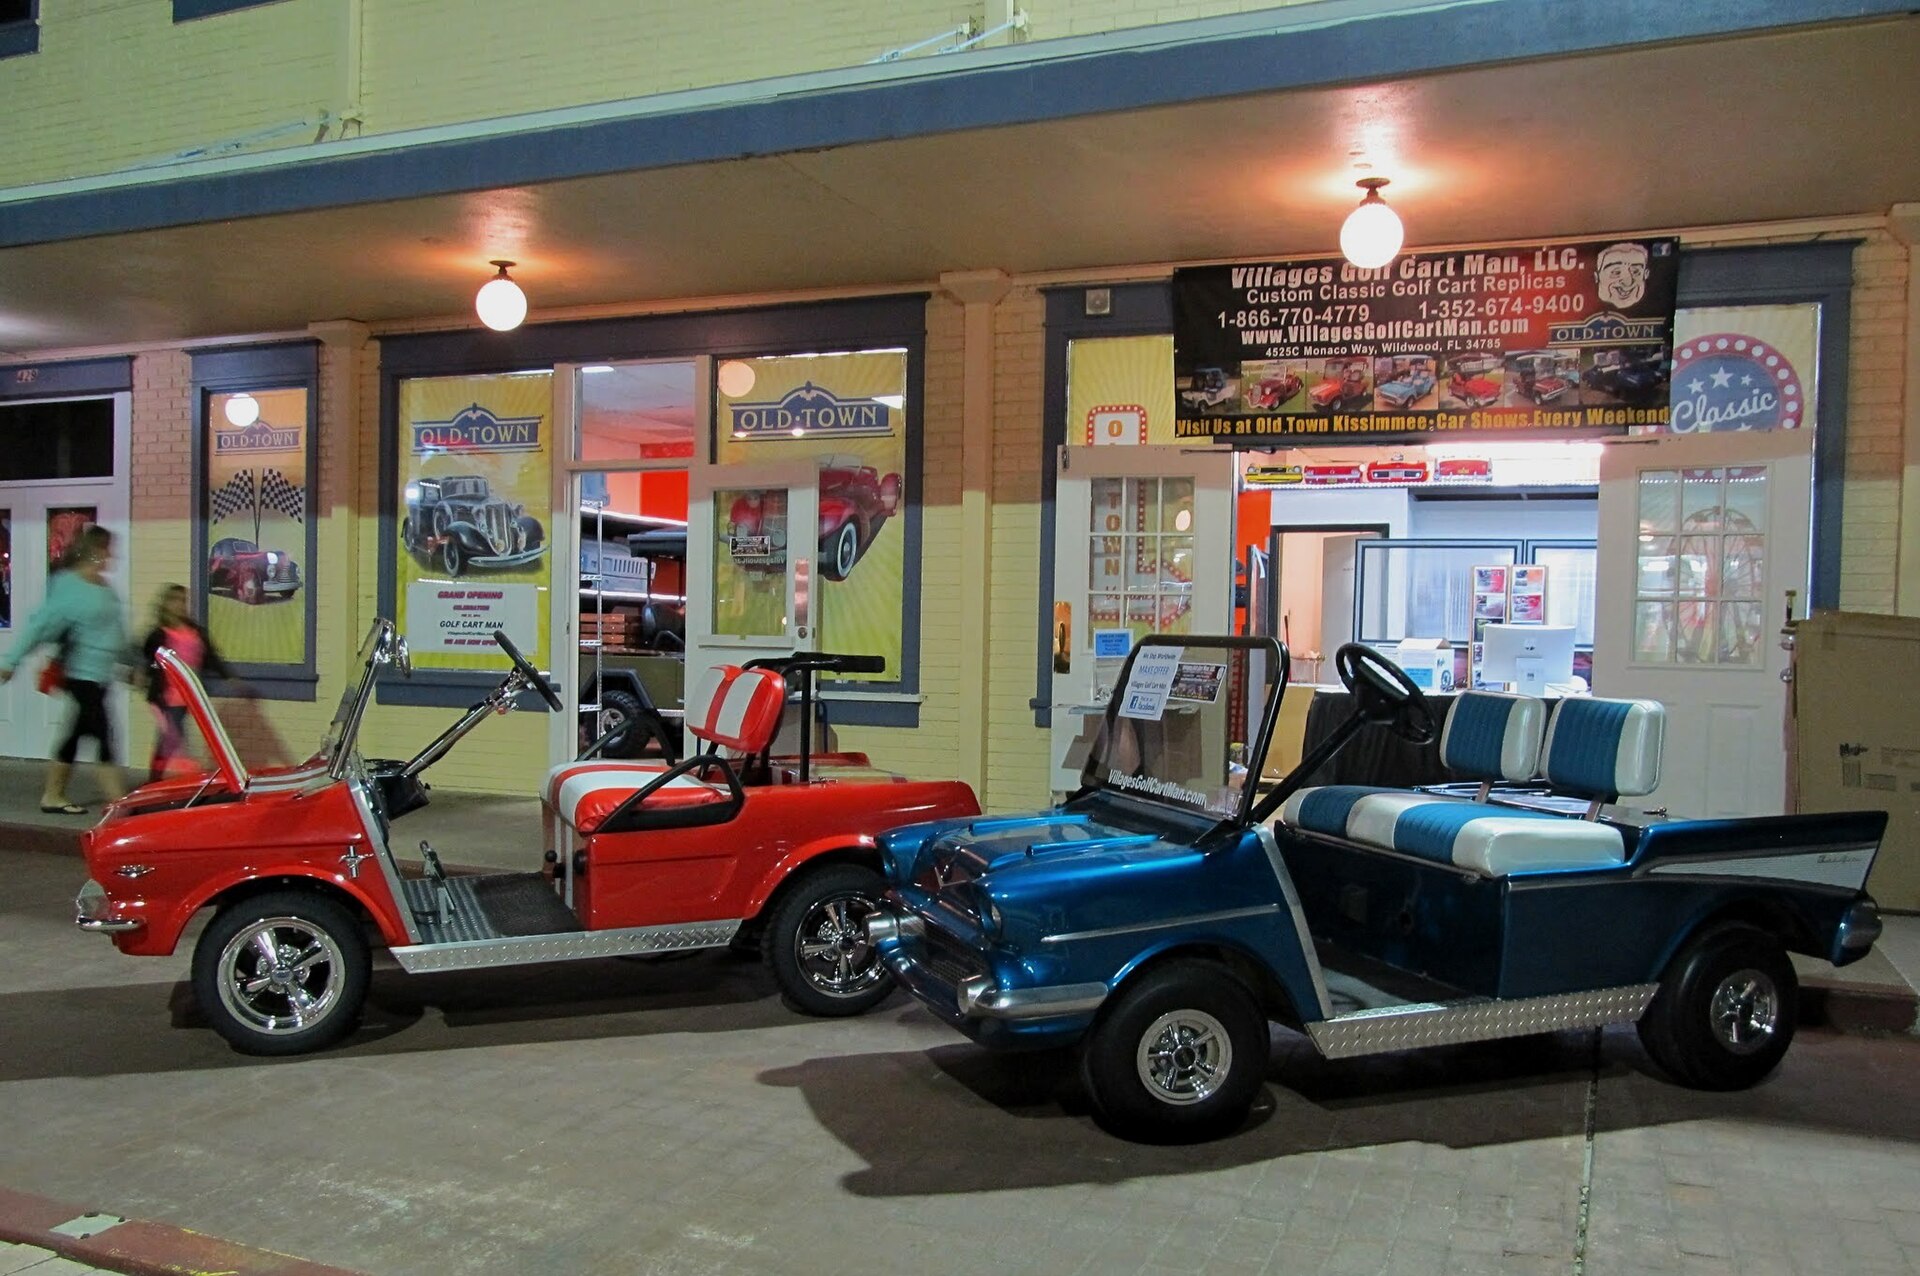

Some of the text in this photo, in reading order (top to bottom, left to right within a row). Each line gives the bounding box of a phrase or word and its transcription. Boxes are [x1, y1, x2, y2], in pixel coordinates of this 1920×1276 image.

[1231, 265, 1333, 289] Villages
[1399, 257, 1455, 280] Cart
[1463, 253, 1525, 276] Man,
[1533, 247, 1585, 272] LLC.
[1246, 274, 1566, 304] Custom Classic Golf Cart Replicas
[1217, 293, 1585, 328] 1-866-770-4779 1-352-674-9400
[1241, 317, 1529, 345] www.VillagesGolfCartMan.com
[1265, 338, 1501, 358] 4525C Monaco Way, Wildwood, FL 34785
[1177, 418, 1210, 435] Visit
[1213, 418, 1231, 434] Us
[1235, 419, 1251, 433] at
[1256, 417, 1285, 433] Old
[1286, 416, 1329, 433] Town
[1436, 413, 1466, 429] Car
[1470, 411, 1528, 428] Shows
[1533, 410, 1582, 428] Every
[1587, 406, 1670, 425] Weekend
[1672, 388, 1778, 433] Classic
[440, 620, 460, 628] GOLF
[485, 621, 504, 629] MAN
[1107, 769, 1207, 807] VillagesGolfCartMan.com
